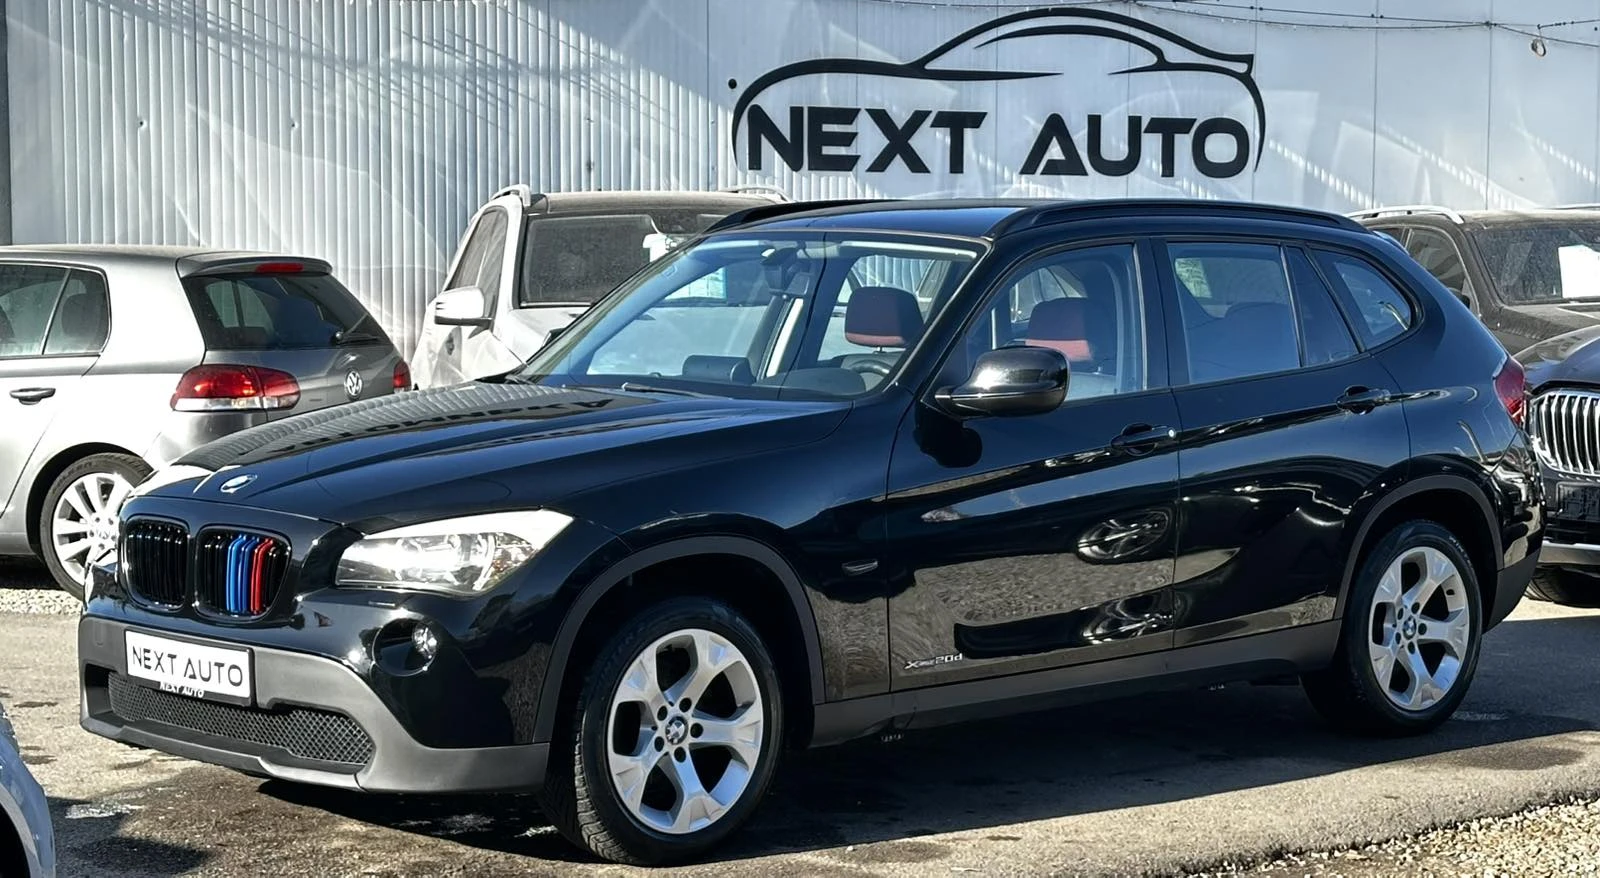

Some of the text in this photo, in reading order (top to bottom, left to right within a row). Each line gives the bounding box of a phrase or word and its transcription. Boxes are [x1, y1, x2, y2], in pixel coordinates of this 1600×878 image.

[748, 104, 1250, 178] NEXT AUTO
[132, 645, 243, 687] NEXT AUTO
